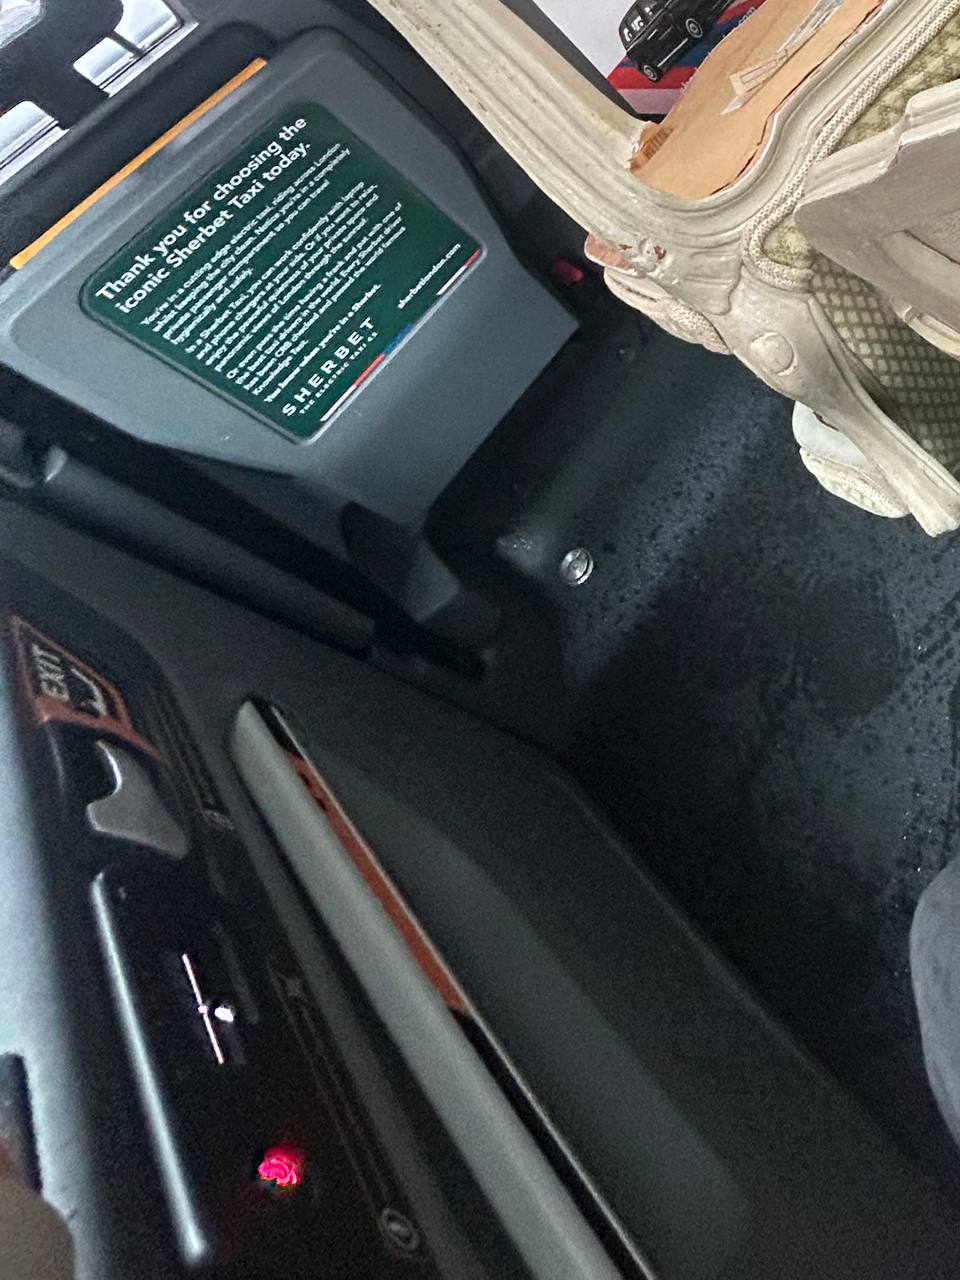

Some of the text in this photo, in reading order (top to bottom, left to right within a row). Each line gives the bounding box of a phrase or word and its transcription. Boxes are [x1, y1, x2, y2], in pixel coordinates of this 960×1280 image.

[95, 118, 307, 299] Thank you for choosing the
[115, 142, 310, 313] iconic Sherbet Taxi today.
[139, 301, 169, 325] You're
[166, 293, 179, 303] in
[176, 287, 185, 295] a
[183, 262, 213, 289] cutting
[210, 243, 231, 263] edge
[229, 218, 258, 245] electric
[271, 185, 295, 206] riding
[293, 165, 316, 187] across
[313, 143, 341, 167] London
[152, 309, 178, 332] whilst
[174, 280, 209, 310] keeping
[205, 267, 221, 281] the
[219, 253, 236, 269] city
[253, 212, 280, 235] Notice
[278, 192, 302, 215] you're
[298, 185, 309, 194] in
[313, 147, 350, 182] completely
[367, 222, 383, 237] with
[381, 210, 395, 224] one
[394, 201, 402, 212] of
[162, 178, 330, 340] private passenger compartment so you can travel
[184, 344, 197, 354] In
[195, 338, 203, 346] a
[199, 309, 232, 339] Sherbet
[246, 279, 263, 295] you
[260, 266, 276, 280] can
[273, 249, 293, 267] work
[291, 214, 329, 250] confidently
[327, 201, 344, 216] with
[340, 181, 365, 202] laptop
[195, 342, 213, 360] and
[210, 320, 236, 346] phone
[234, 290, 266, 321] chargers
[264, 281, 275, 291] at
[272, 265, 289, 284] your
[304, 240, 316, 251] Or
[313, 232, 323, 242] if
[320, 222, 336, 238] you
[333, 206, 352, 224] want
[349, 199, 360, 208] to
[205, 192, 379, 366] enjoy the peaceful quietness of your private space and
[321, 276, 329, 284] a
[324, 260, 345, 278] frank
[343, 246, 358, 262] and
[397, 243, 461, 309] sherbetlondon.com
[170, 302, 217, 345] hygienically
[214, 286, 232, 304] and
[214, 333, 253, 373] panoramic
[250, 312, 272, 333] views
[270, 302, 280, 314] of
[277, 278, 306, 305] London
[303, 253, 332, 280] through
[329, 242, 343, 254] the
[234, 371, 250, 385] the
[246, 353, 267, 372] best
[263, 339, 280, 355] taxi
[278, 316, 303, 341] drivers
[299, 308, 310, 317] in
[307, 296, 322, 310] the
[338, 258, 361, 278] Every
[357, 233, 385, 260] Sherbet
[383, 215, 402, 235] driver
[242, 376, 259, 391] has
[255, 357, 277, 377] been
[290, 312, 320, 342] checked
[318, 298, 333, 314] and
[330, 275, 355, 302] passed
[352, 265, 366, 278] the
[364, 246, 384, 267] world
[381, 226, 406, 249] famous
[270, 320, 285, 333] the
[282, 304, 301, 321] time
[297, 282, 324, 305] having
[225, 367, 239, 379] Or
[238, 349, 257, 368] even
[252, 355, 293, 395] Knowledge
[263, 387, 282, 402] You
[277, 366, 301, 389] know
[298, 346, 320, 367] when
[318, 324, 341, 349] you're
[338, 316, 349, 325] in
[351, 284, 381, 312] Sherbet.
[282, 317, 373, 416] SHERBET
[298, 342, 367, 414] THE ELECTRIC TAXI
[31, 642, 69, 701] EXIT
